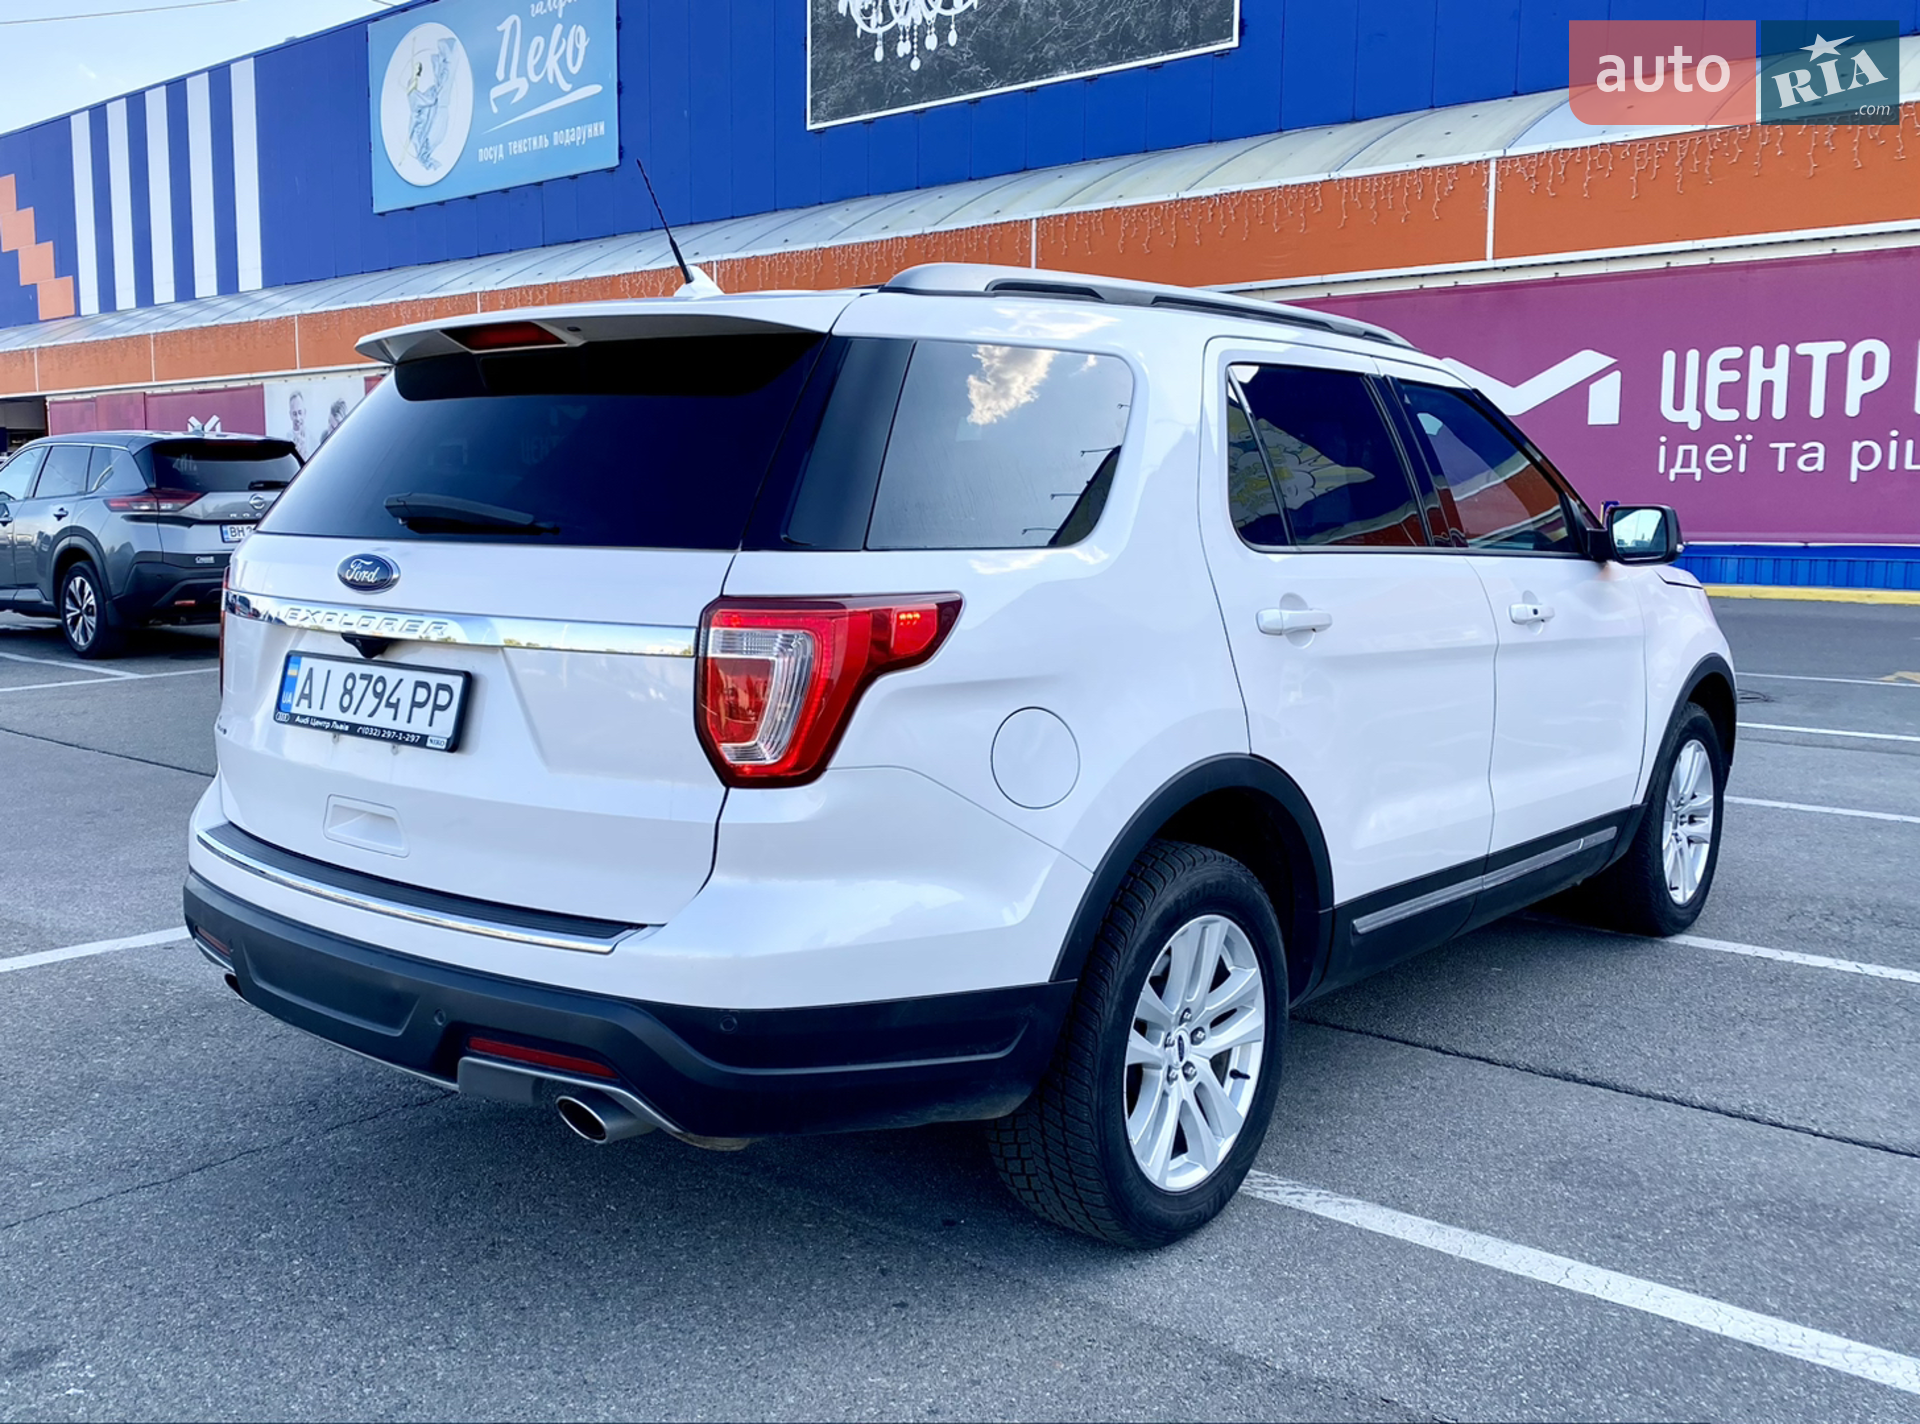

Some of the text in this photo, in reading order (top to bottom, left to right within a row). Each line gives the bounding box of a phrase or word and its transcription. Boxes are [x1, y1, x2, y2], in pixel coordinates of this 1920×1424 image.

[490, 14, 590, 114] Деко
[478, 121, 604, 164] посуд текстиль подарунки
[1660, 339, 1891, 431] ЦЕНТР
[1658, 434, 1753, 482] ідеї
[1769, 441, 1826, 472] та
[345, 558, 381, 583] Ford
[284, 607, 449, 636] EXPLORER
[295, 667, 454, 727] AI 8794 PP
[295, 715, 310, 725] Audi
